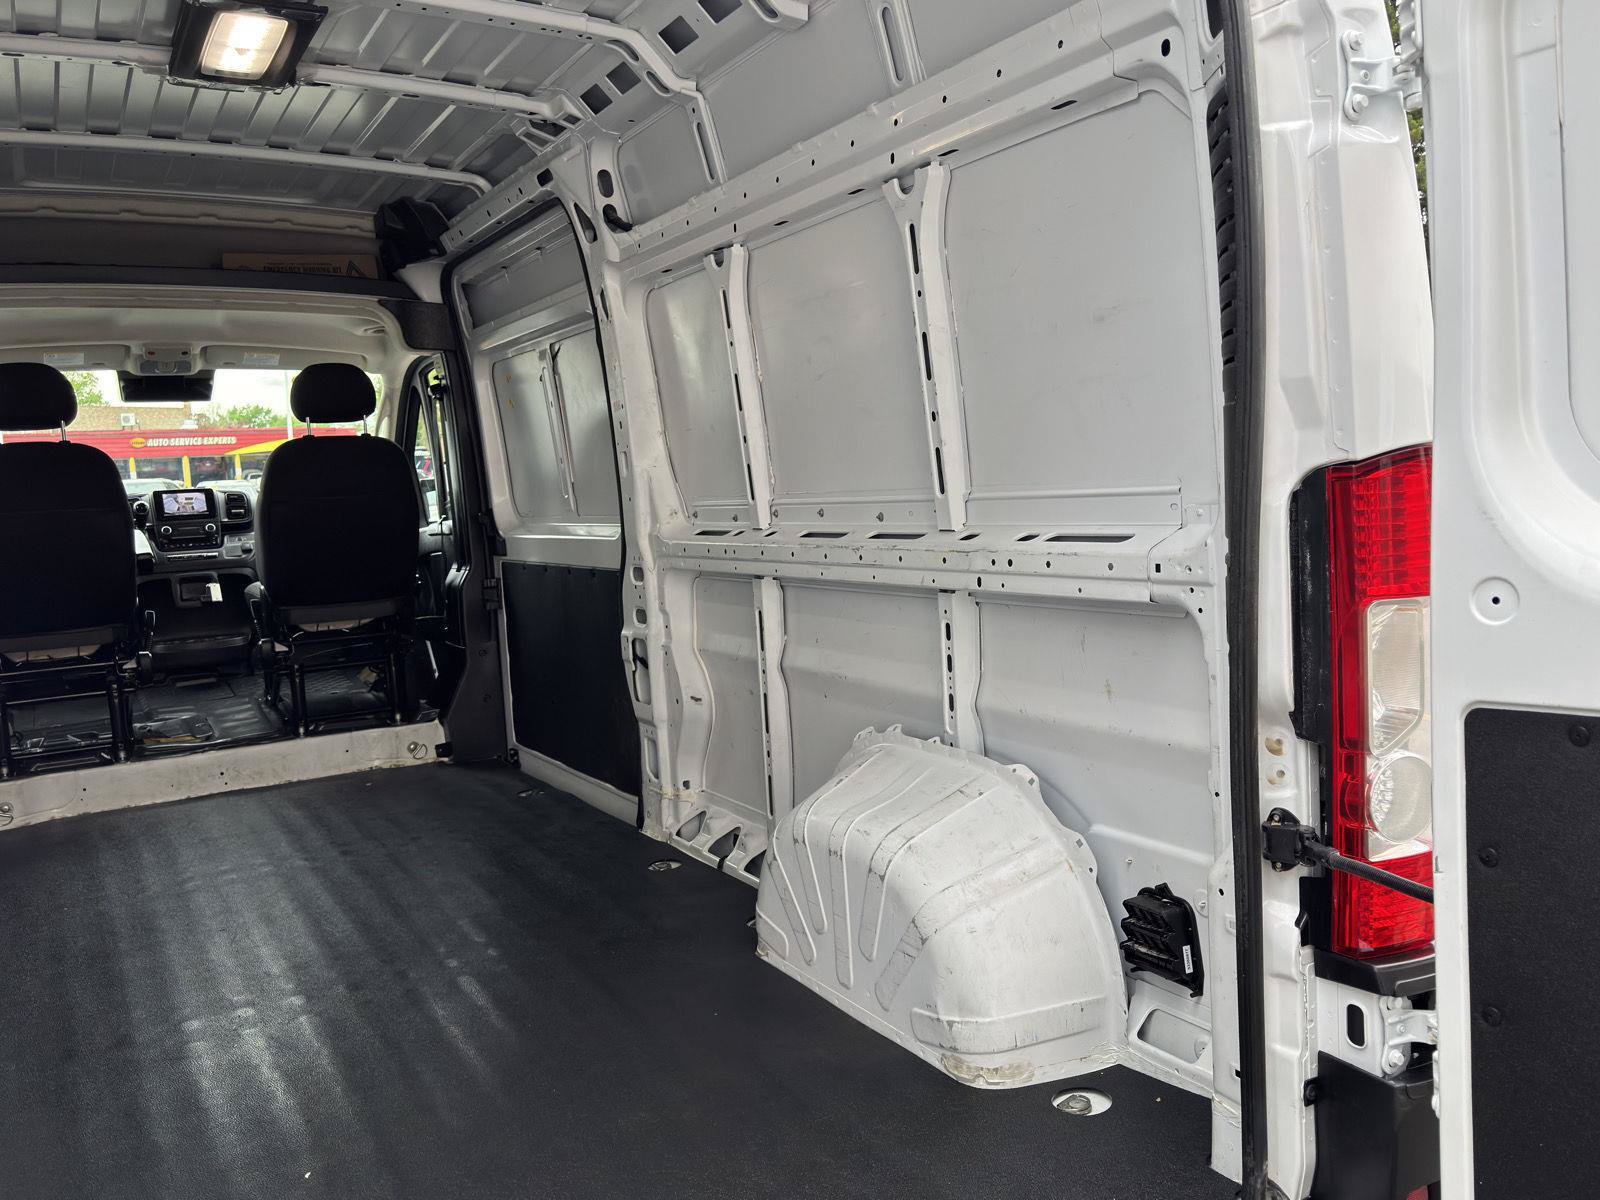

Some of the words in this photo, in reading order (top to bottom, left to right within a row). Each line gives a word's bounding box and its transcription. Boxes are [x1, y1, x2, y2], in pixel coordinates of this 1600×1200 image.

[147, 438, 169, 446] AUTO
[170, 437, 202, 445] SERVICE
[203, 436, 236, 444] EXPERTS
